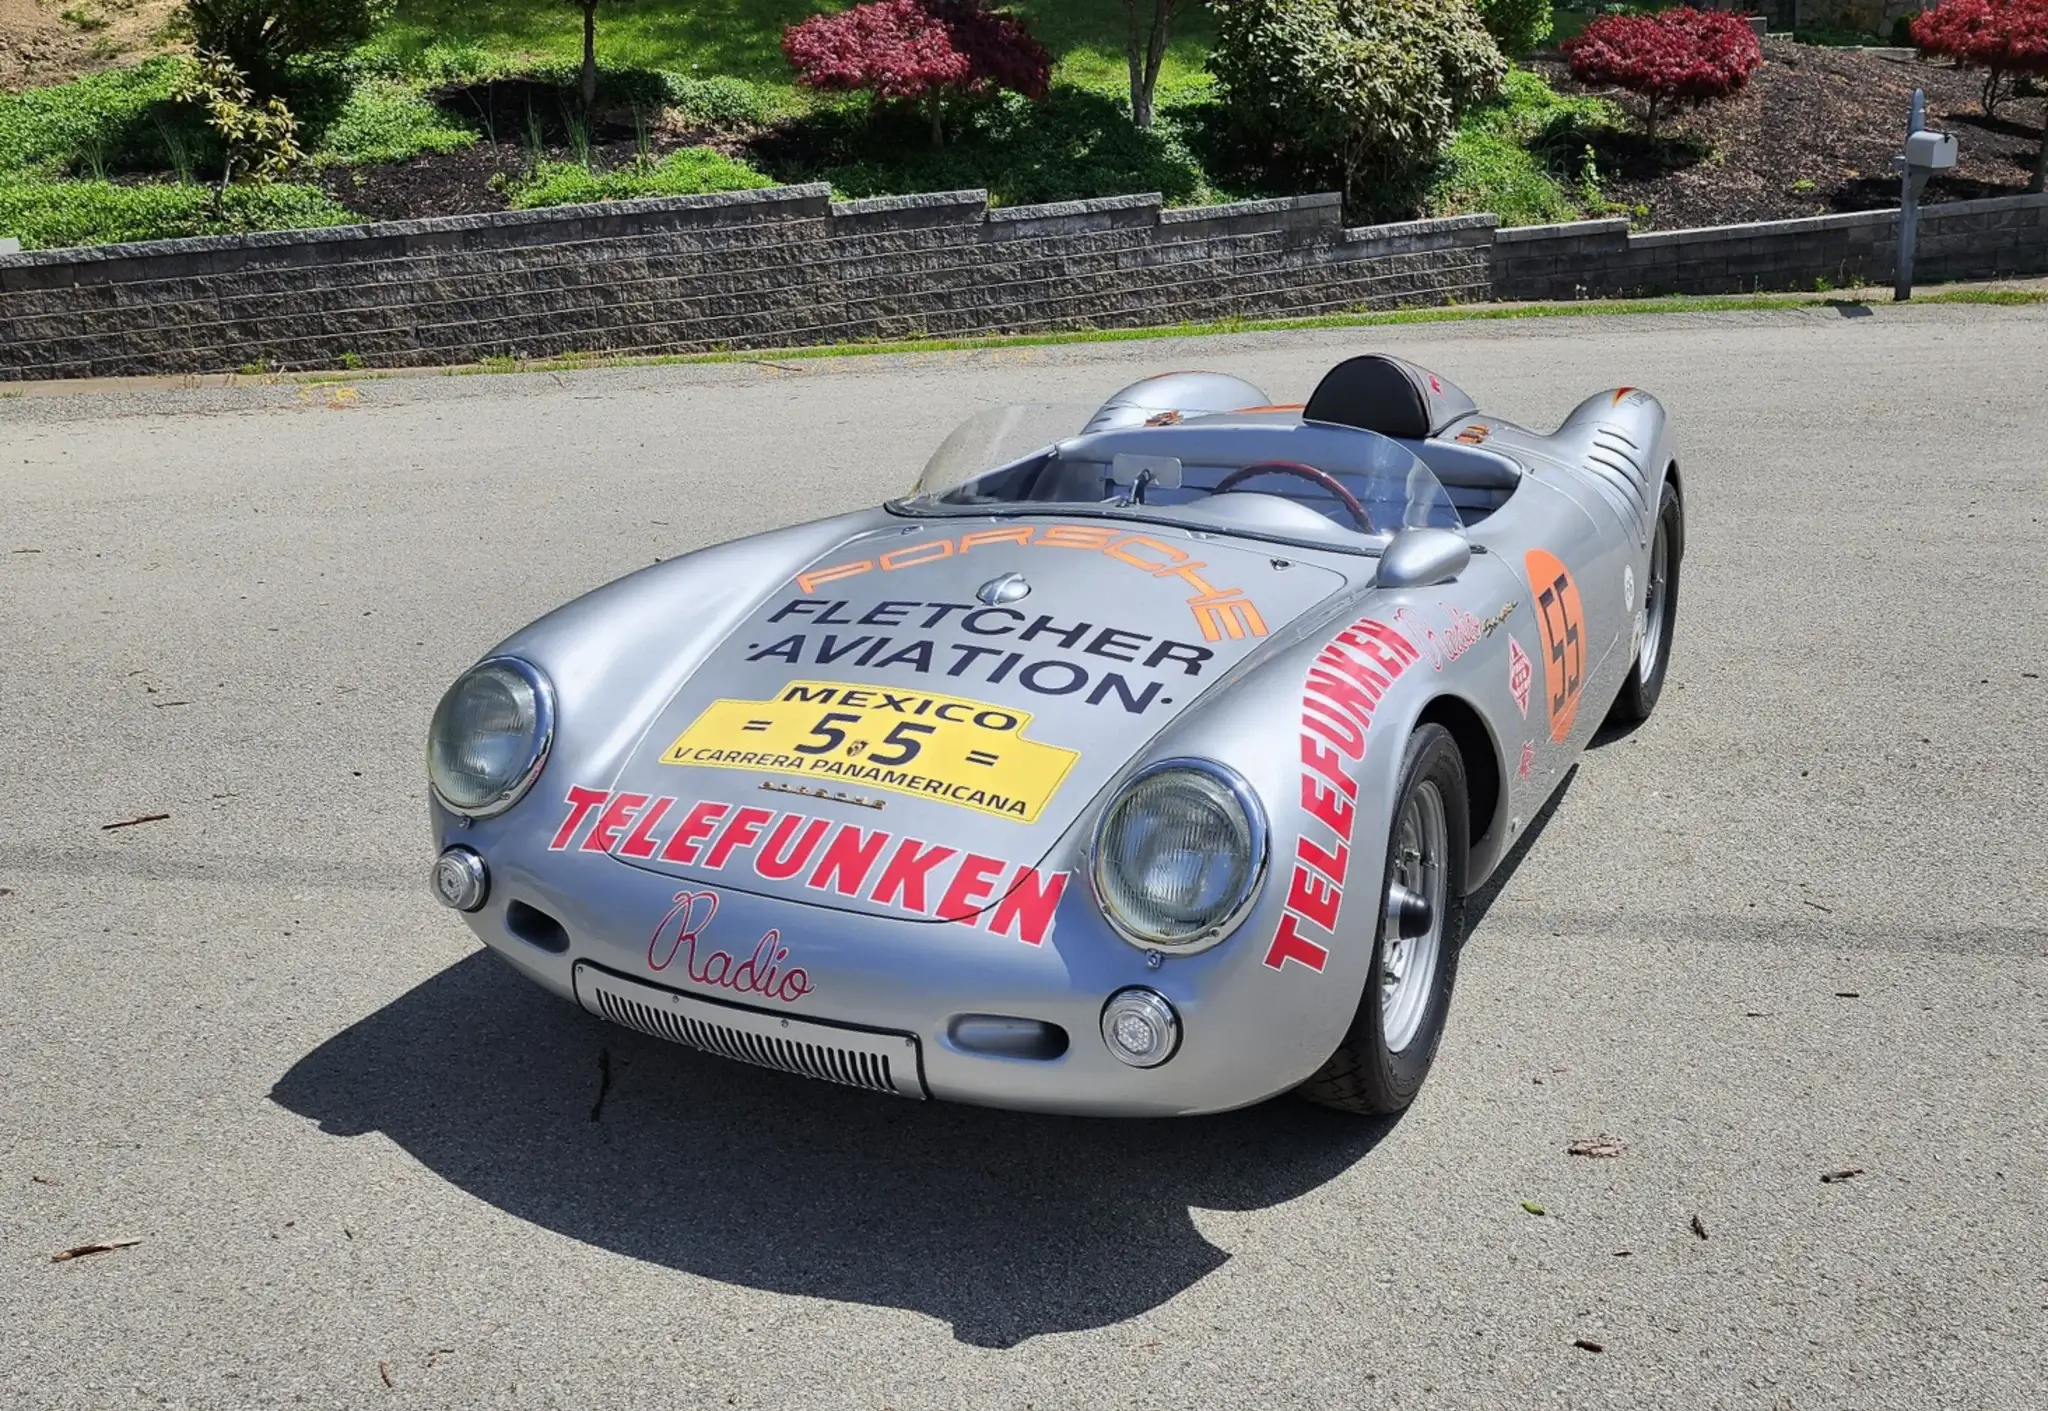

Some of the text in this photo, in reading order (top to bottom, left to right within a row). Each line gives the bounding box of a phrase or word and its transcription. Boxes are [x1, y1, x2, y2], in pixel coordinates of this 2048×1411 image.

[767, 600, 1214, 677] FLETCHER
[797, 524, 1269, 643] PORSCHE
[1539, 573, 1581, 716] 55
[783, 686, 1018, 731] MEXICO
[673, 747, 1027, 816] V CARRERA PANAMERICANA
[1263, 616, 1422, 974] TELEFUNKEN
[549, 785, 1070, 947] TELEFUNKEN
[647, 890, 815, 1002] Radio
